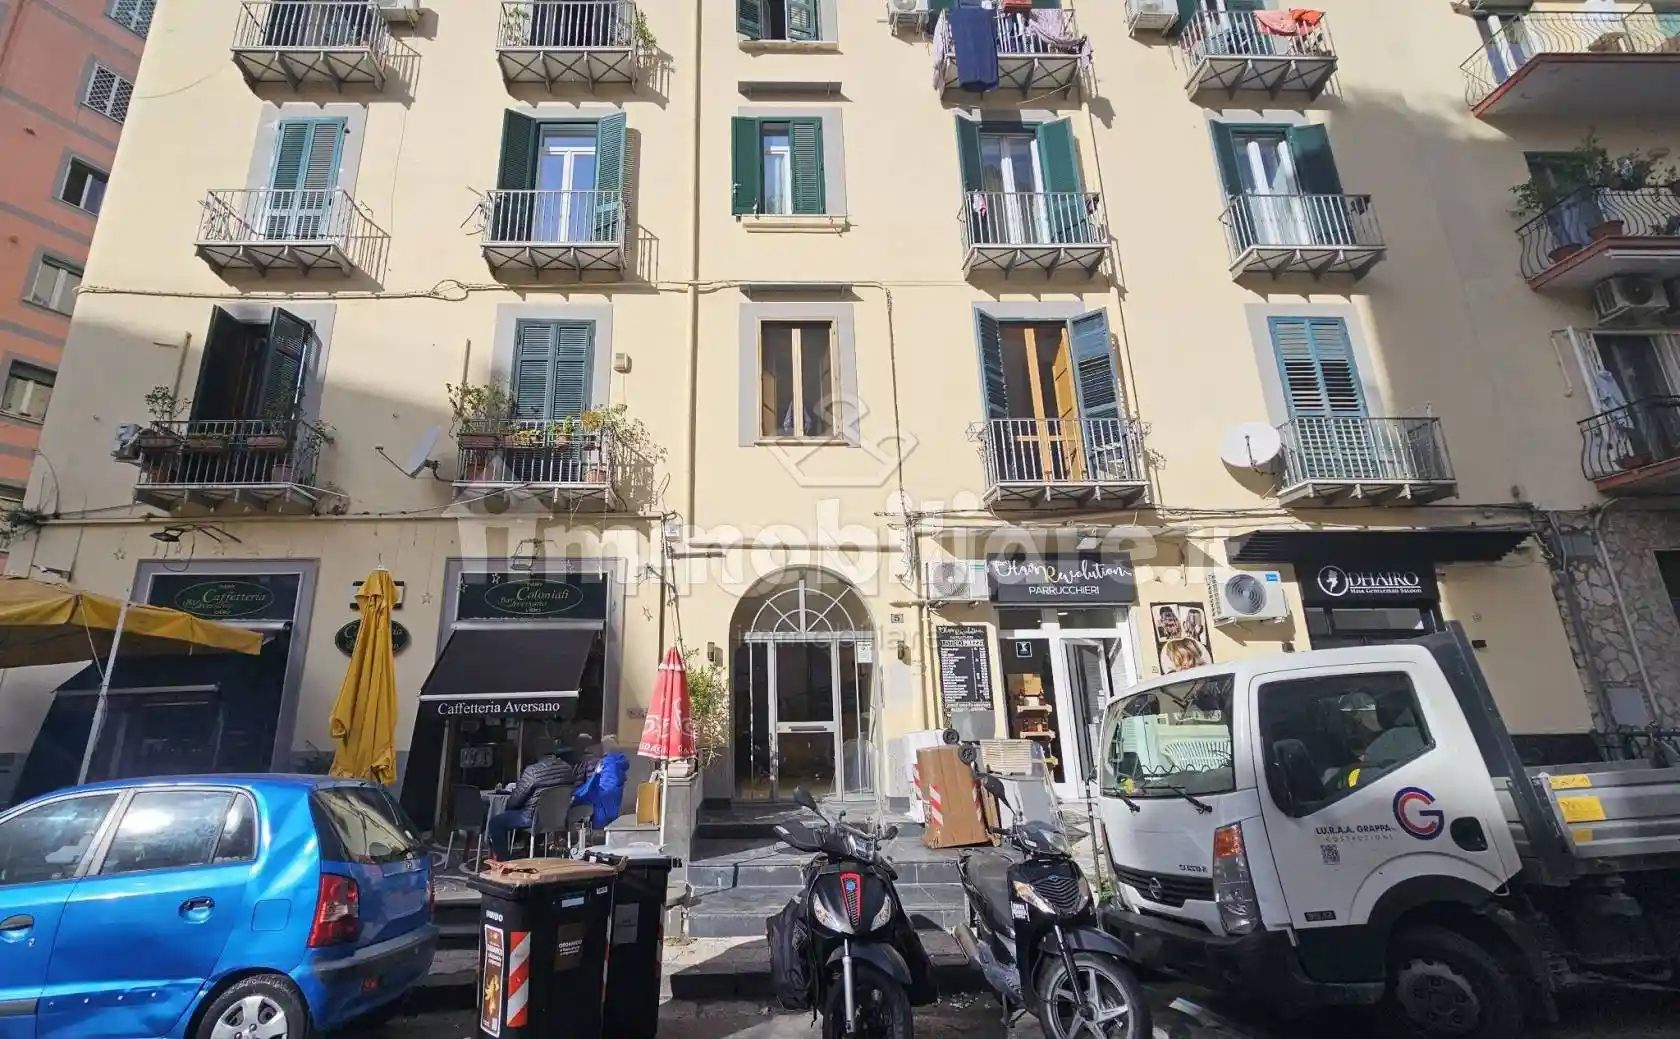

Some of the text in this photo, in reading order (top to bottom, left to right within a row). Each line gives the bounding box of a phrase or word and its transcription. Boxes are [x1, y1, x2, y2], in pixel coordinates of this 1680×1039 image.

[1046, 560, 1132, 584] Revolution
[202, 588, 266, 605] Caffetteria
[1029, 585, 1100, 595] PARRUCCHIERI
[438, 701, 560, 715] Caffetteria Aversano
[1356, 824, 1391, 833] GRAPPA
